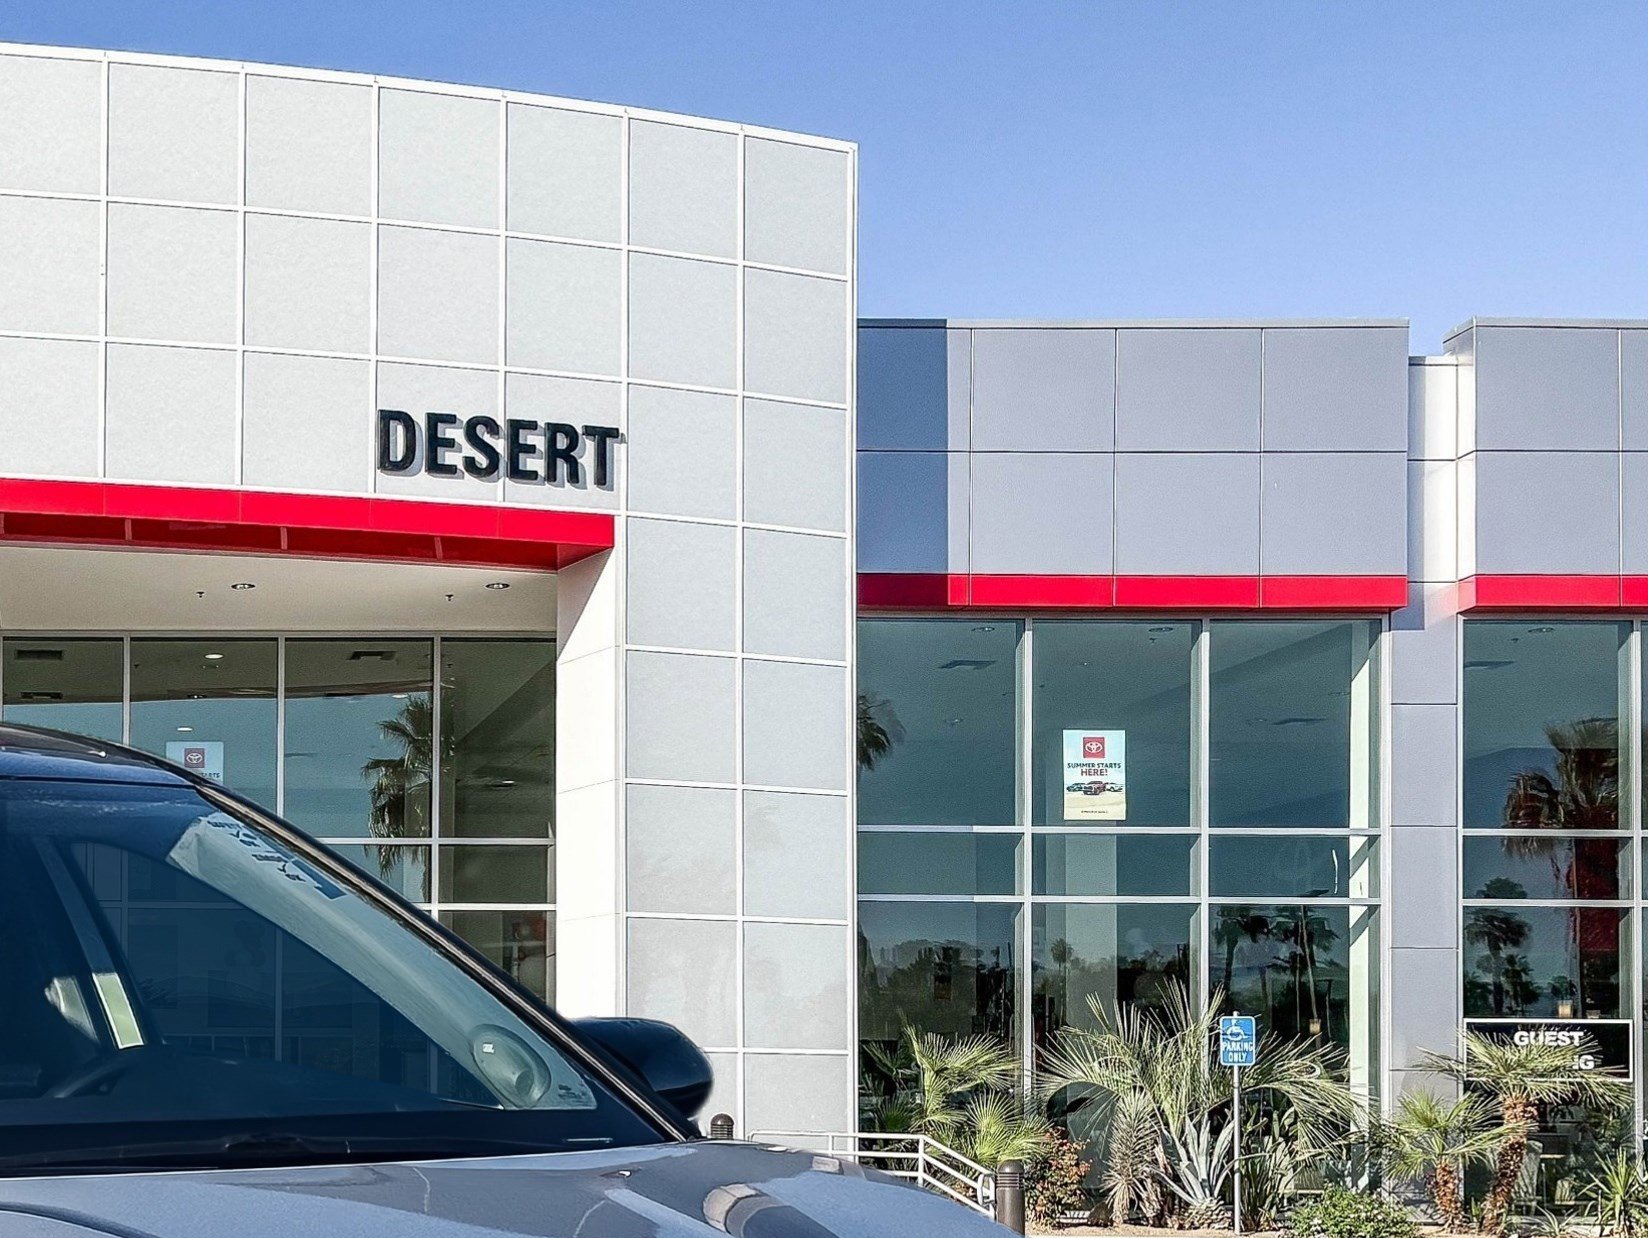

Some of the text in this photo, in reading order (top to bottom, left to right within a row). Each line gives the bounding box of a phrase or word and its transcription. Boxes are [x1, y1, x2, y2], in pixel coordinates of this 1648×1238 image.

[377, 409, 620, 486] DESERT
[1513, 1031, 1584, 1046] GUEST
[1223, 1042, 1253, 1051] PARKING
[1229, 1052, 1247, 1062] ONLY
